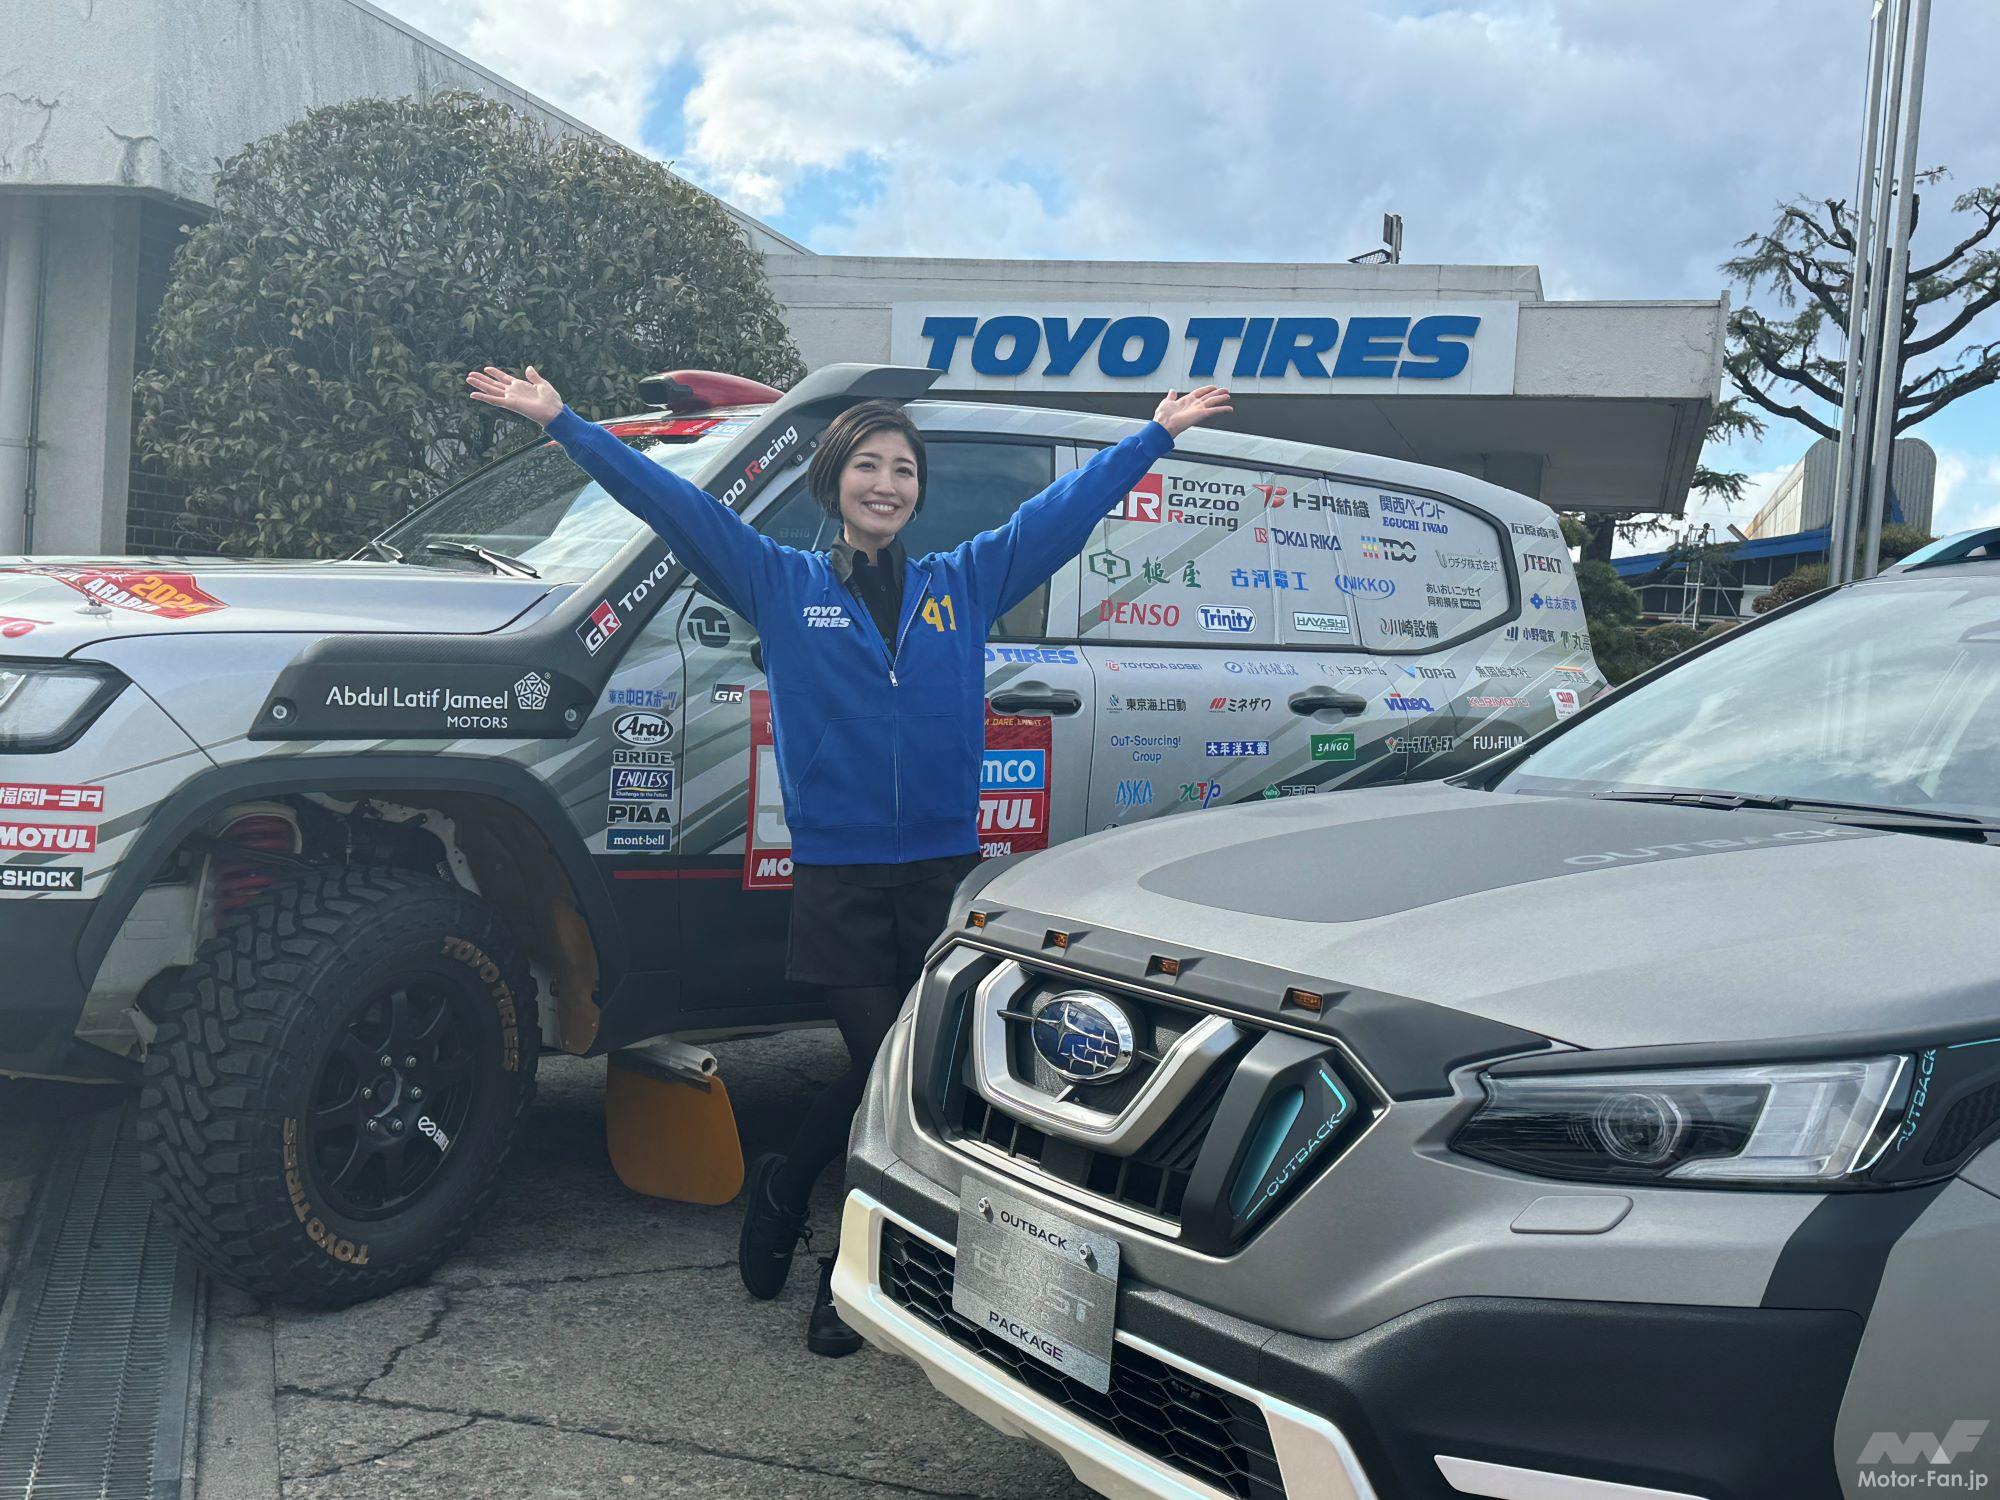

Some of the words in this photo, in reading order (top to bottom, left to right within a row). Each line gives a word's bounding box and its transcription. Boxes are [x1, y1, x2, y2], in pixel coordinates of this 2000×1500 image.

[921, 316, 1170, 376] TOYO
[1184, 316, 1482, 378] TIRES
[744, 425, 799, 481] Racing
[1168, 476, 1246, 496] TOYOTA
[1168, 493, 1239, 512] GAZOO
[1293, 492, 1370, 518] トヨタ紡織
[1379, 494, 1446, 519] 関西ペイント
[1168, 510, 1238, 531] Racing
[1383, 517, 1419, 531] EGUCHI
[1422, 520, 1448, 535] IWAO
[1271, 528, 1307, 547] TOKAI
[1310, 530, 1342, 550] RIKA
[1379, 537, 1416, 563] TDC
[1523, 554, 1562, 574] JTEKT
[617, 551, 677, 612] TOYOT
[1344, 576, 1390, 594] NIKKO
[130, 576, 210, 612] 2024
[803, 606, 841, 617] TOYO
[922, 595, 956, 632] 41
[1100, 600, 1180, 627] DENSO
[1200, 608, 1253, 631] Trinity
[585, 611, 621, 651] GR
[807, 618, 851, 628] TIRES
[1297, 617, 1347, 628] HAYASHI
[997, 648, 1078, 664] TIRES
[1121, 662, 1167, 670] TOYODA
[326, 686, 388, 707] Abdul
[394, 687, 440, 708] Latif
[443, 688, 508, 711] Jameel
[714, 691, 743, 702] GR
[1126, 698, 1186, 712] 東京海上日動
[1228, 698, 1271, 712] ミネザワ
[447, 716, 508, 729] MOTORS
[618, 716, 667, 736] Arai
[614, 750, 673, 764] BRIDE
[1133, 751, 1161, 764] Group
[1207, 742, 1268, 756] 太平洋工業
[1318, 743, 1348, 752] SANGO
[617, 771, 670, 787] ENDLESS
[1115, 780, 1153, 817] ASKA
[608, 806, 671, 823] PIAA
[978, 799, 1036, 830] TUL
[0, 826, 91, 848] MOTUL
[983, 842, 1011, 858] 2024
[440, 936, 500, 983] TOYO
[1266, 1113, 1341, 1197] OUTBACK
[283, 1117, 311, 1223] TIRES
[306, 1217, 370, 1265] TOYO
[1001, 1210, 1068, 1251] OUTBACK
[989, 1311, 1063, 1363] PACKAGE
